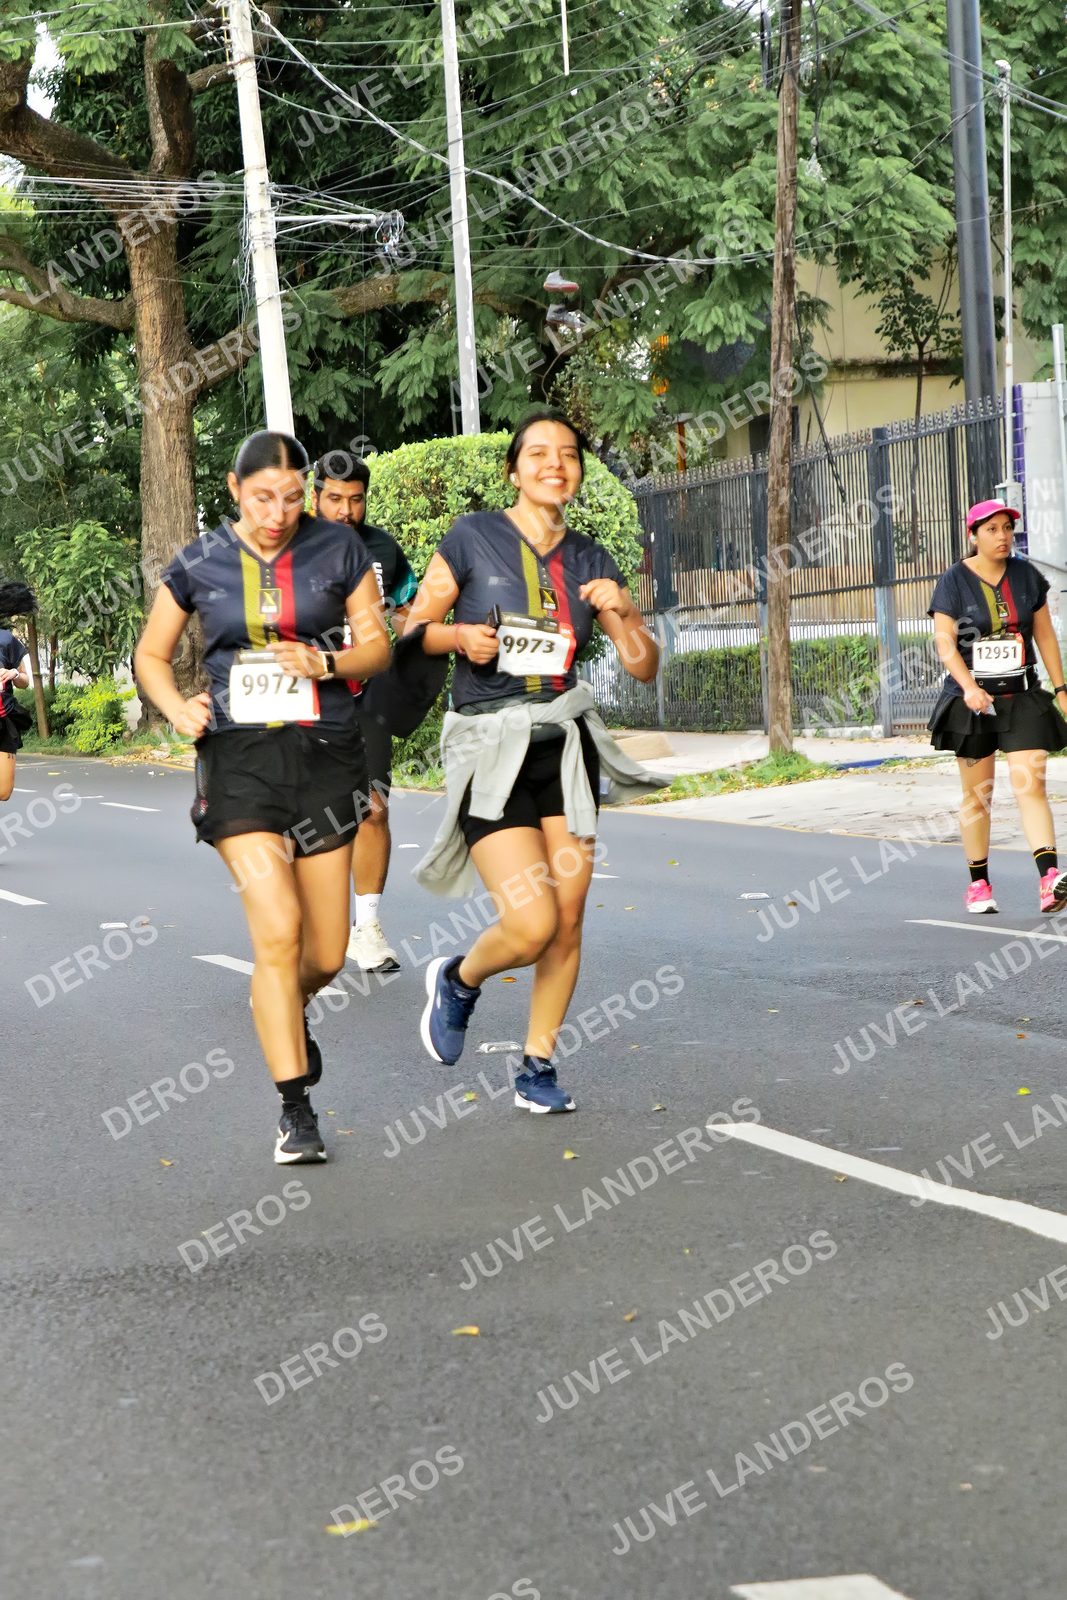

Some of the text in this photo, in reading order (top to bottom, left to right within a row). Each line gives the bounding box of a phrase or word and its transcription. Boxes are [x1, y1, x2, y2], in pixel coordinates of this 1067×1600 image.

[502, 635, 556, 654] 9973
[976, 645, 1018, 661] 12951
[241, 673, 299, 697] 9972
